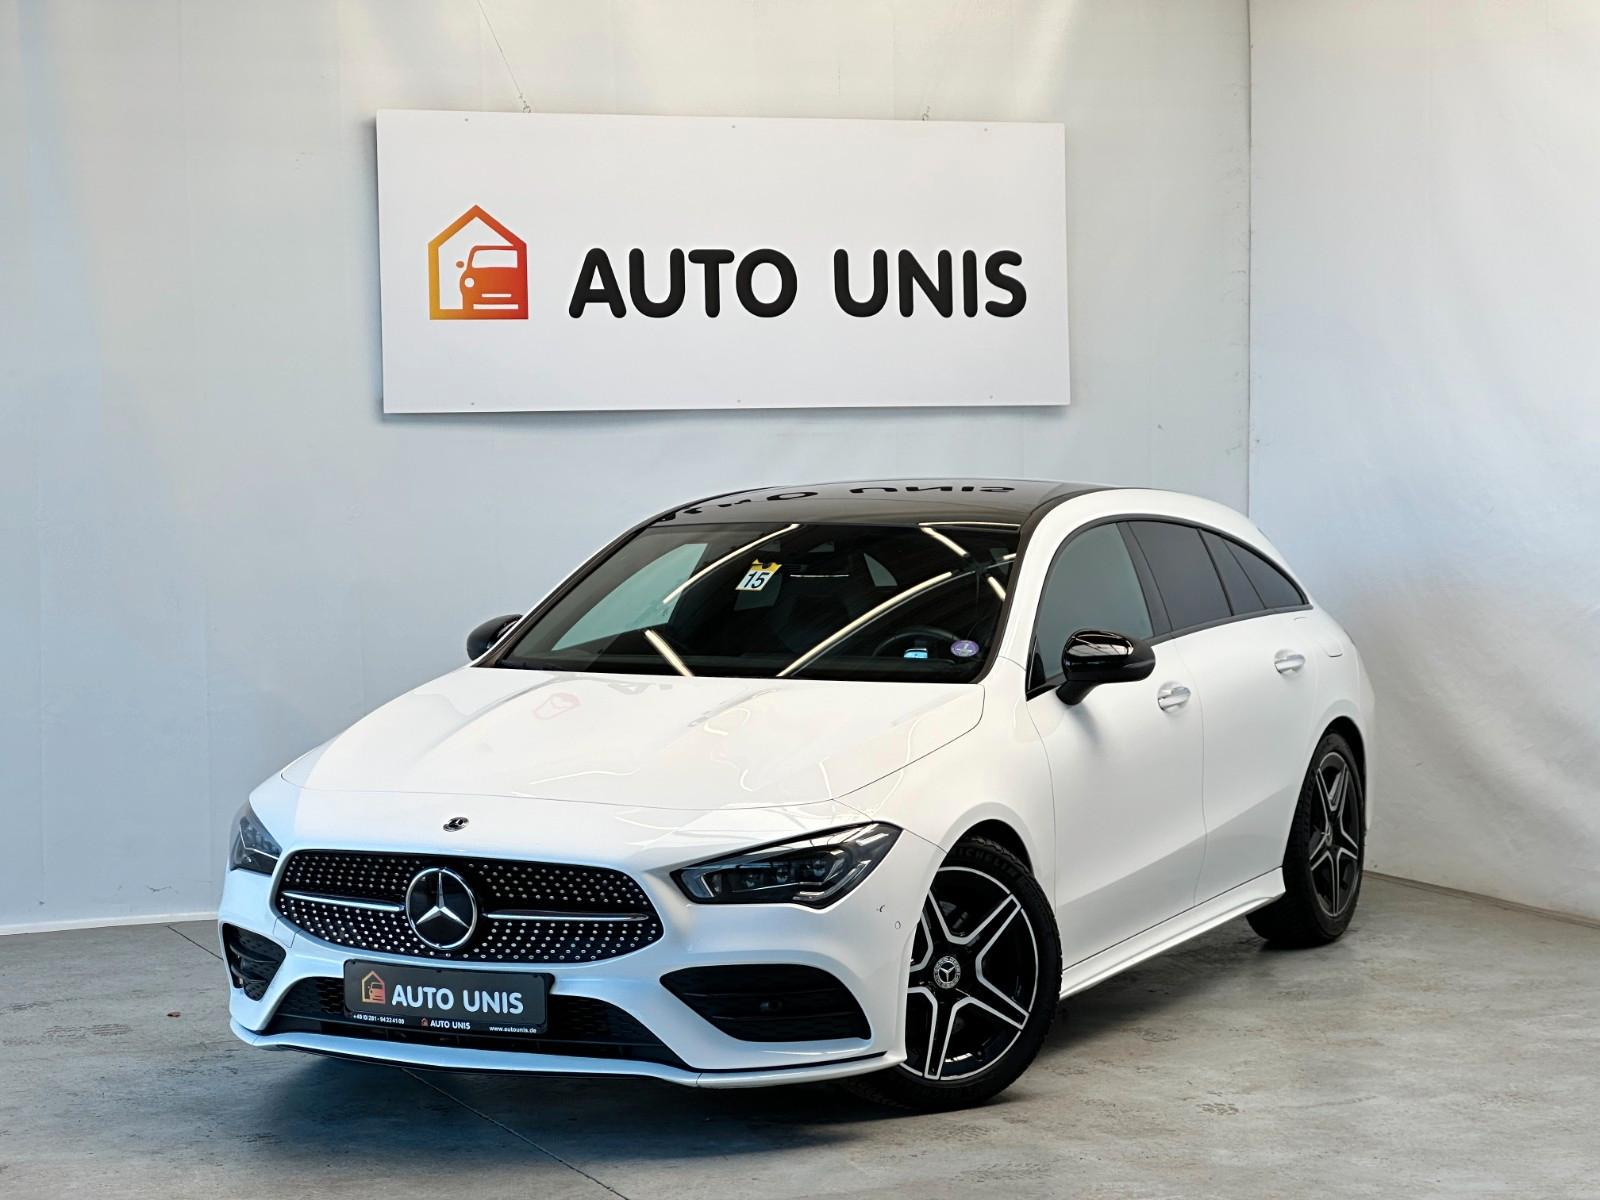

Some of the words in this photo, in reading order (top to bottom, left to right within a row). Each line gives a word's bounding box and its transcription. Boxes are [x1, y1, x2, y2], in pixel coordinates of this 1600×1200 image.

[568, 247, 798, 319] AUTO
[833, 248, 1027, 319] UNIS
[744, 571, 770, 588] 15
[391, 984, 455, 1011] AUTO
[462, 989, 524, 1014] UNIS
[430, 1019, 450, 1029] AUTO
[452, 1021, 471, 1030] UNIS
[489, 1025, 537, 1034] www.autounis.de
